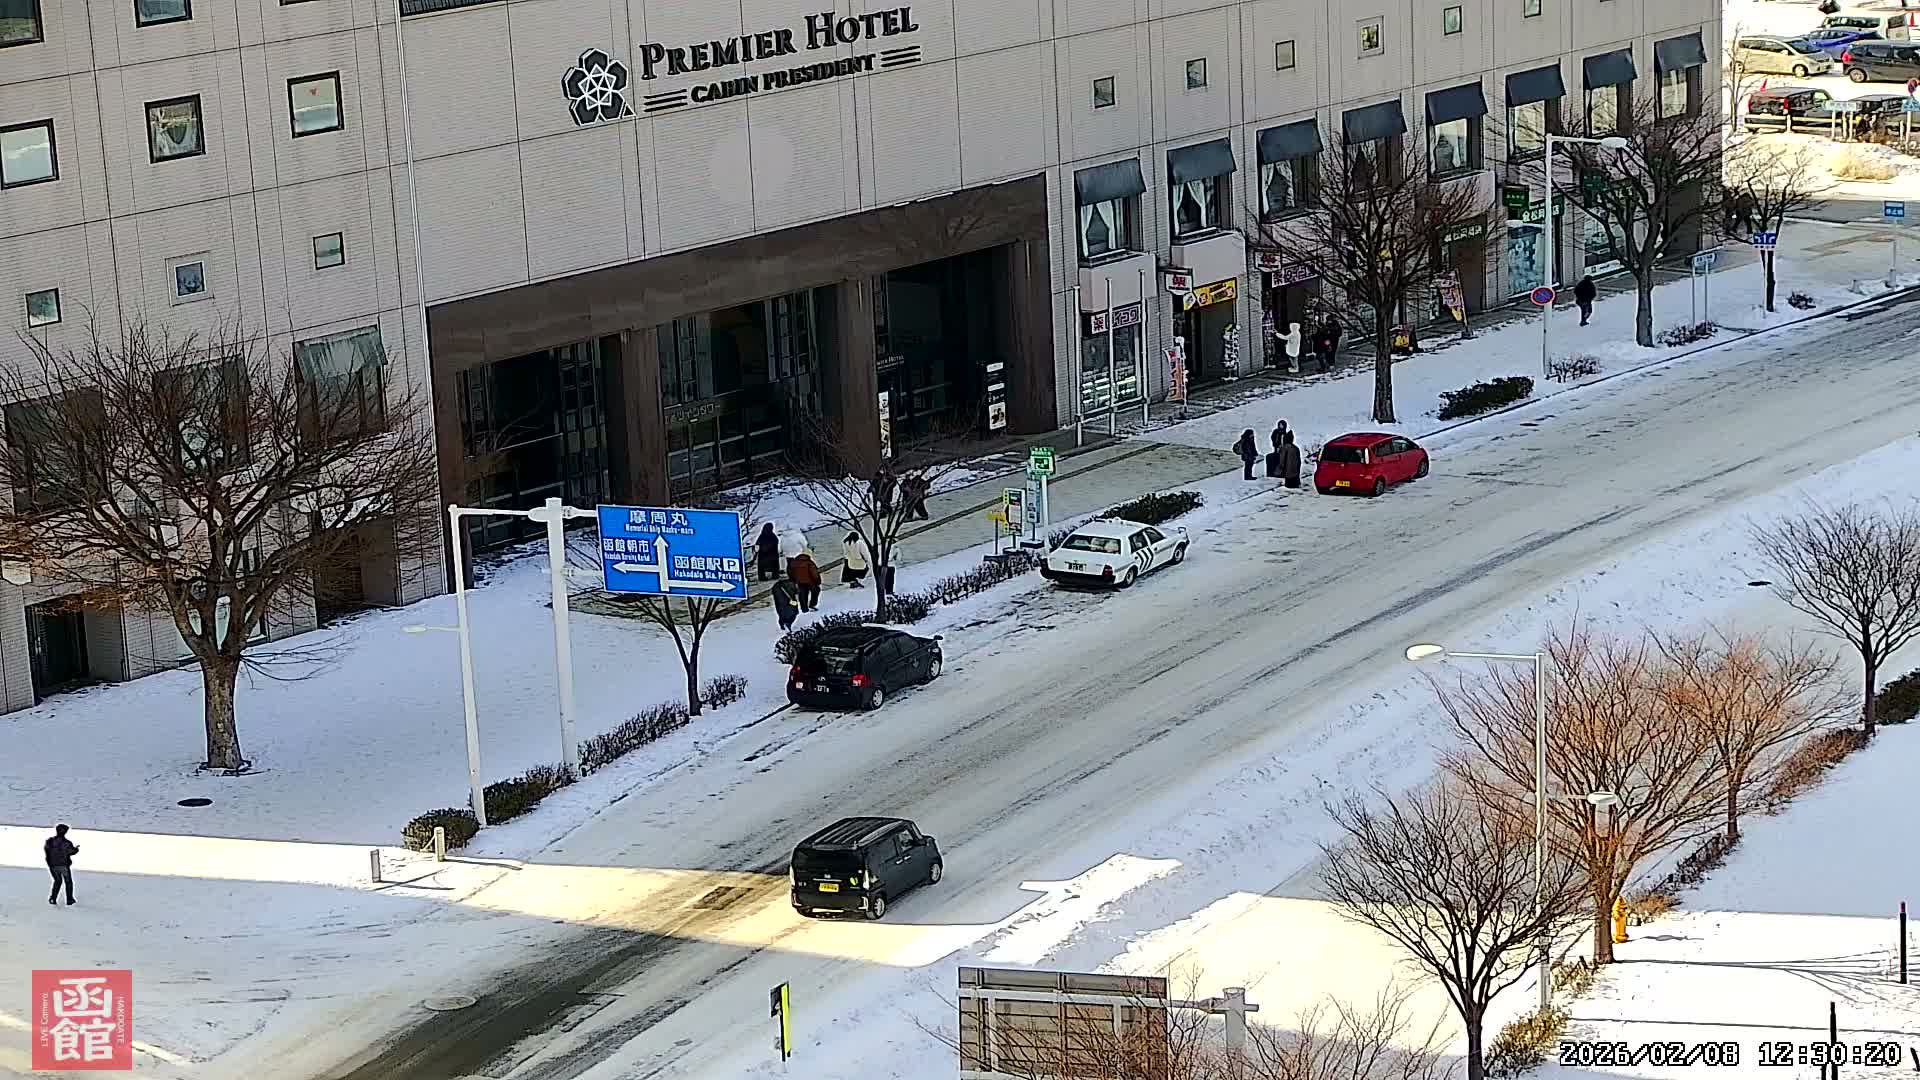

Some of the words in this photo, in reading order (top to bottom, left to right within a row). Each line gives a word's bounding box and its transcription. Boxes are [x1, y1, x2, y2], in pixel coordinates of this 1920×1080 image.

[639, 27, 798, 80] PREMIER
[804, 6, 919, 50] HOTEL
[690, 74, 759, 103] CABIN
[762, 54, 876, 93] PRESIDENT
[629, 510, 688, 526] 摩周丸
[603, 538, 649, 553] 函館朝市
